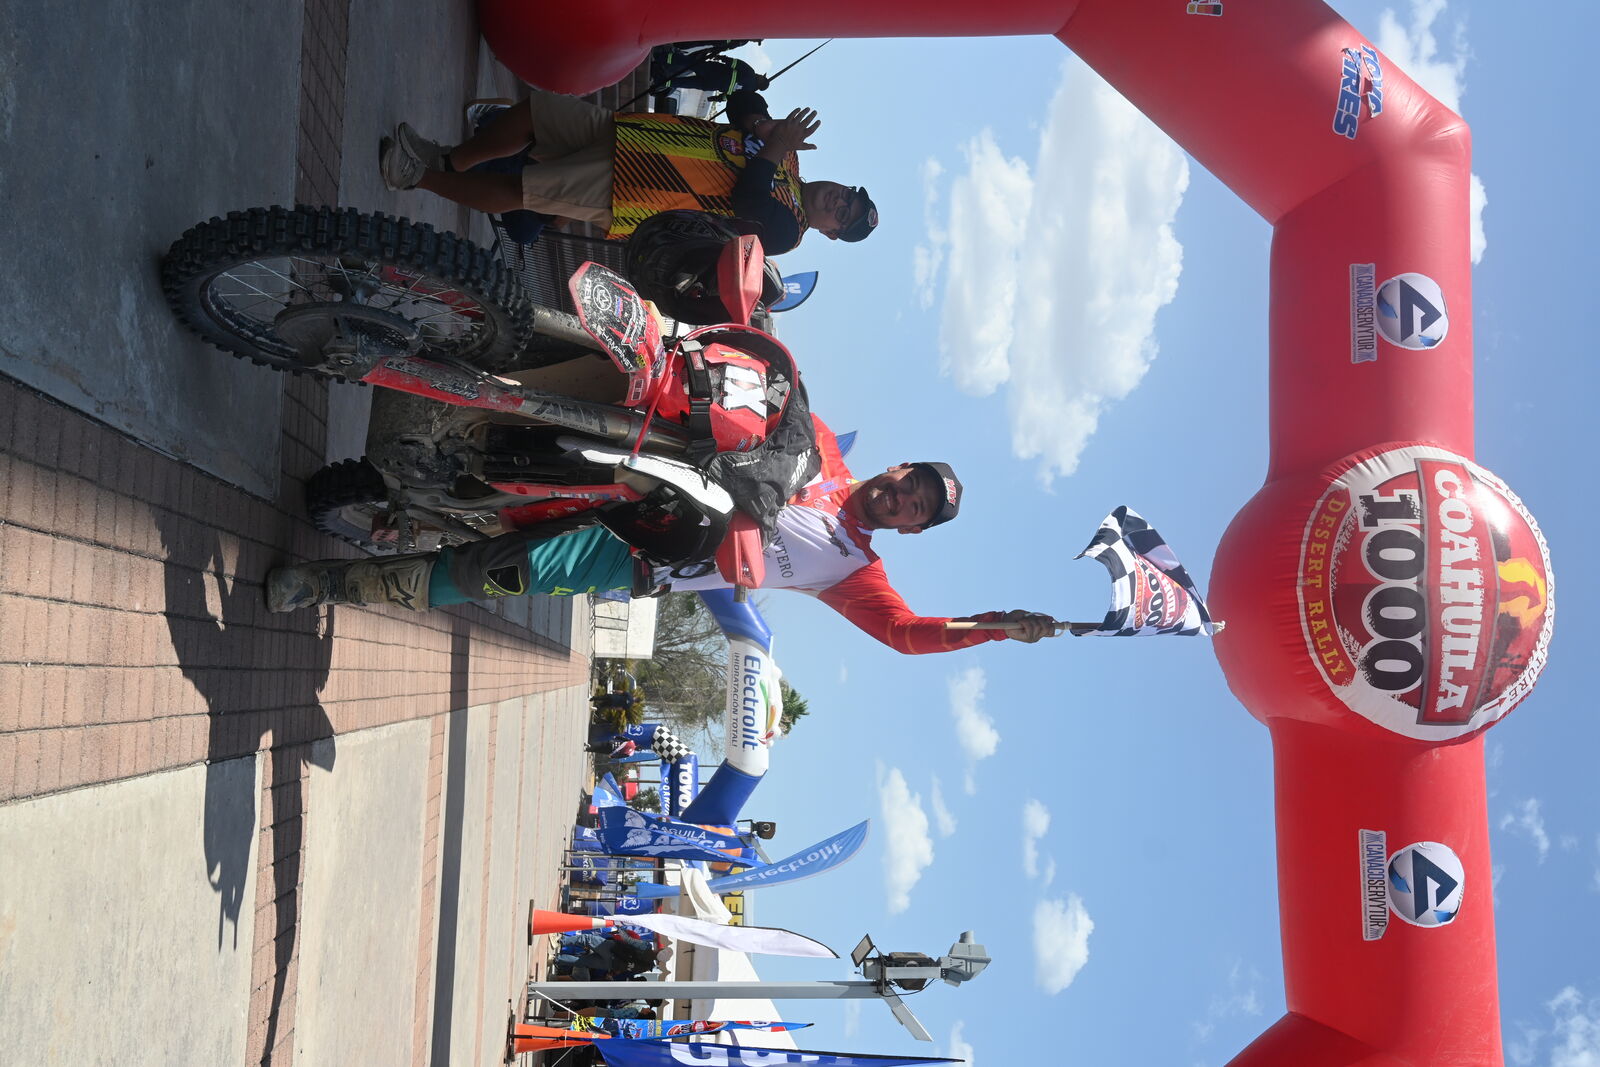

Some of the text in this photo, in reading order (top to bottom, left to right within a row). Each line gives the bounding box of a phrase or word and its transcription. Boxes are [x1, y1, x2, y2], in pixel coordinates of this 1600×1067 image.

[1332, 49, 1362, 140] TIRES
[770, 526, 794, 579] ONTERO
[1307, 498, 1347, 676] DESERT RALLY
[1358, 493, 1426, 692] 1000
[1434, 469, 1485, 713] COAHUILA
[731, 718, 739, 748] TOTAL!
[742, 654, 761, 752] Electrolit
[678, 762, 693, 809] TOYO
